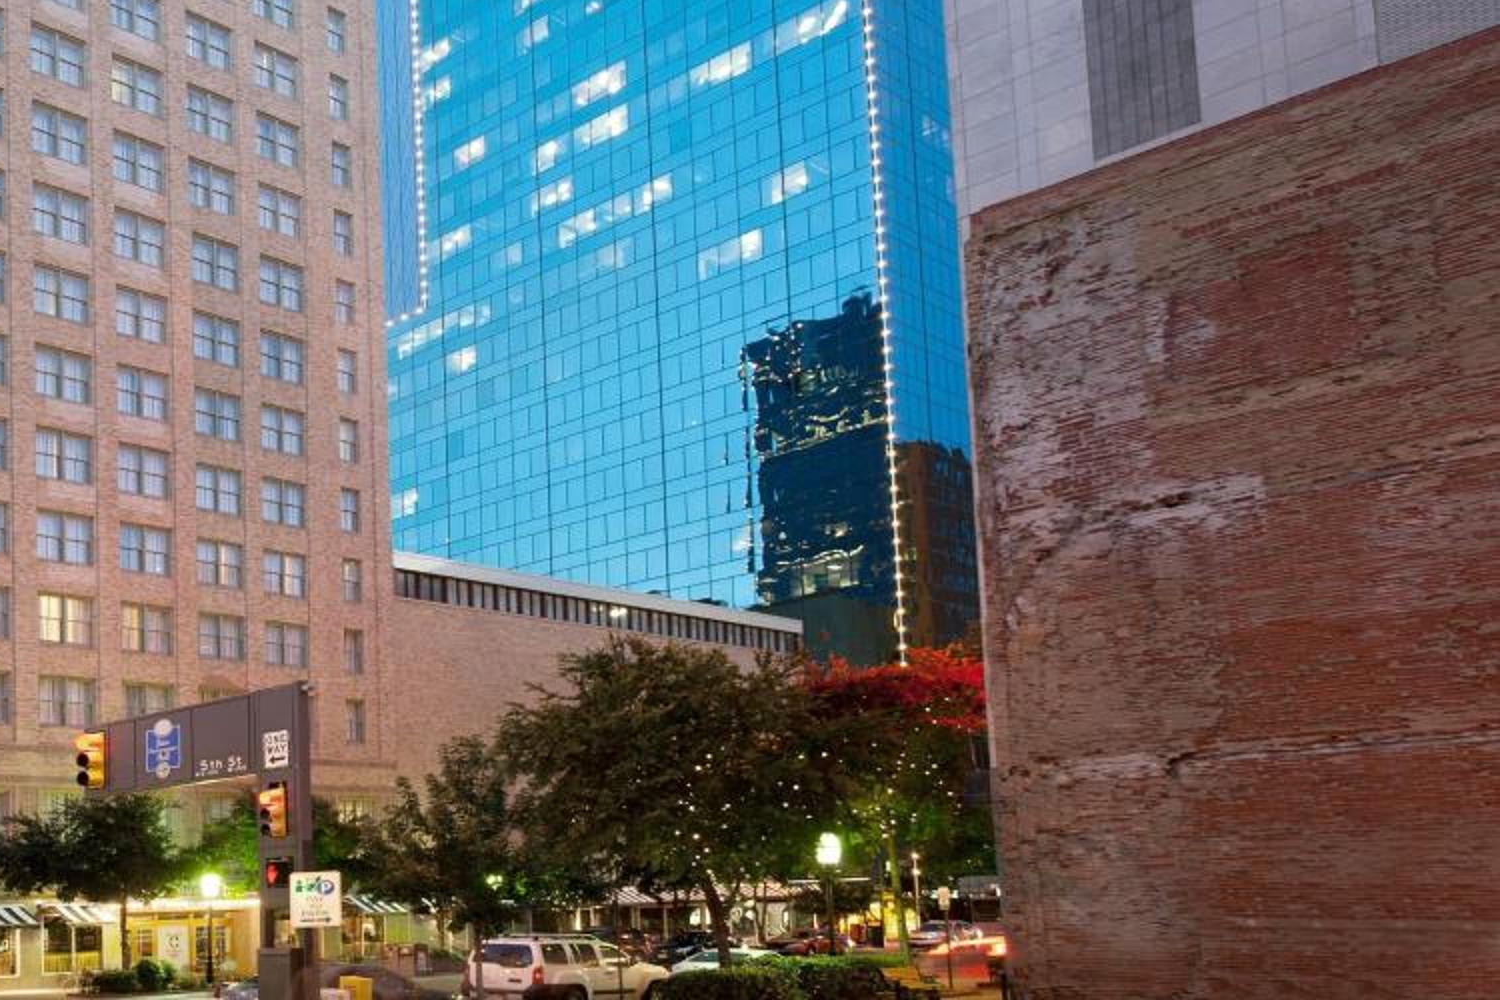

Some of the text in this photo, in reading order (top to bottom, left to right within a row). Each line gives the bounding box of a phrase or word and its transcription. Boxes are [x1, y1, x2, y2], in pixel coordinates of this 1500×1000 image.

[264, 733, 288, 744] ONE
[267, 743, 287, 755] WAY
[199, 755, 242, 771] 5th St
